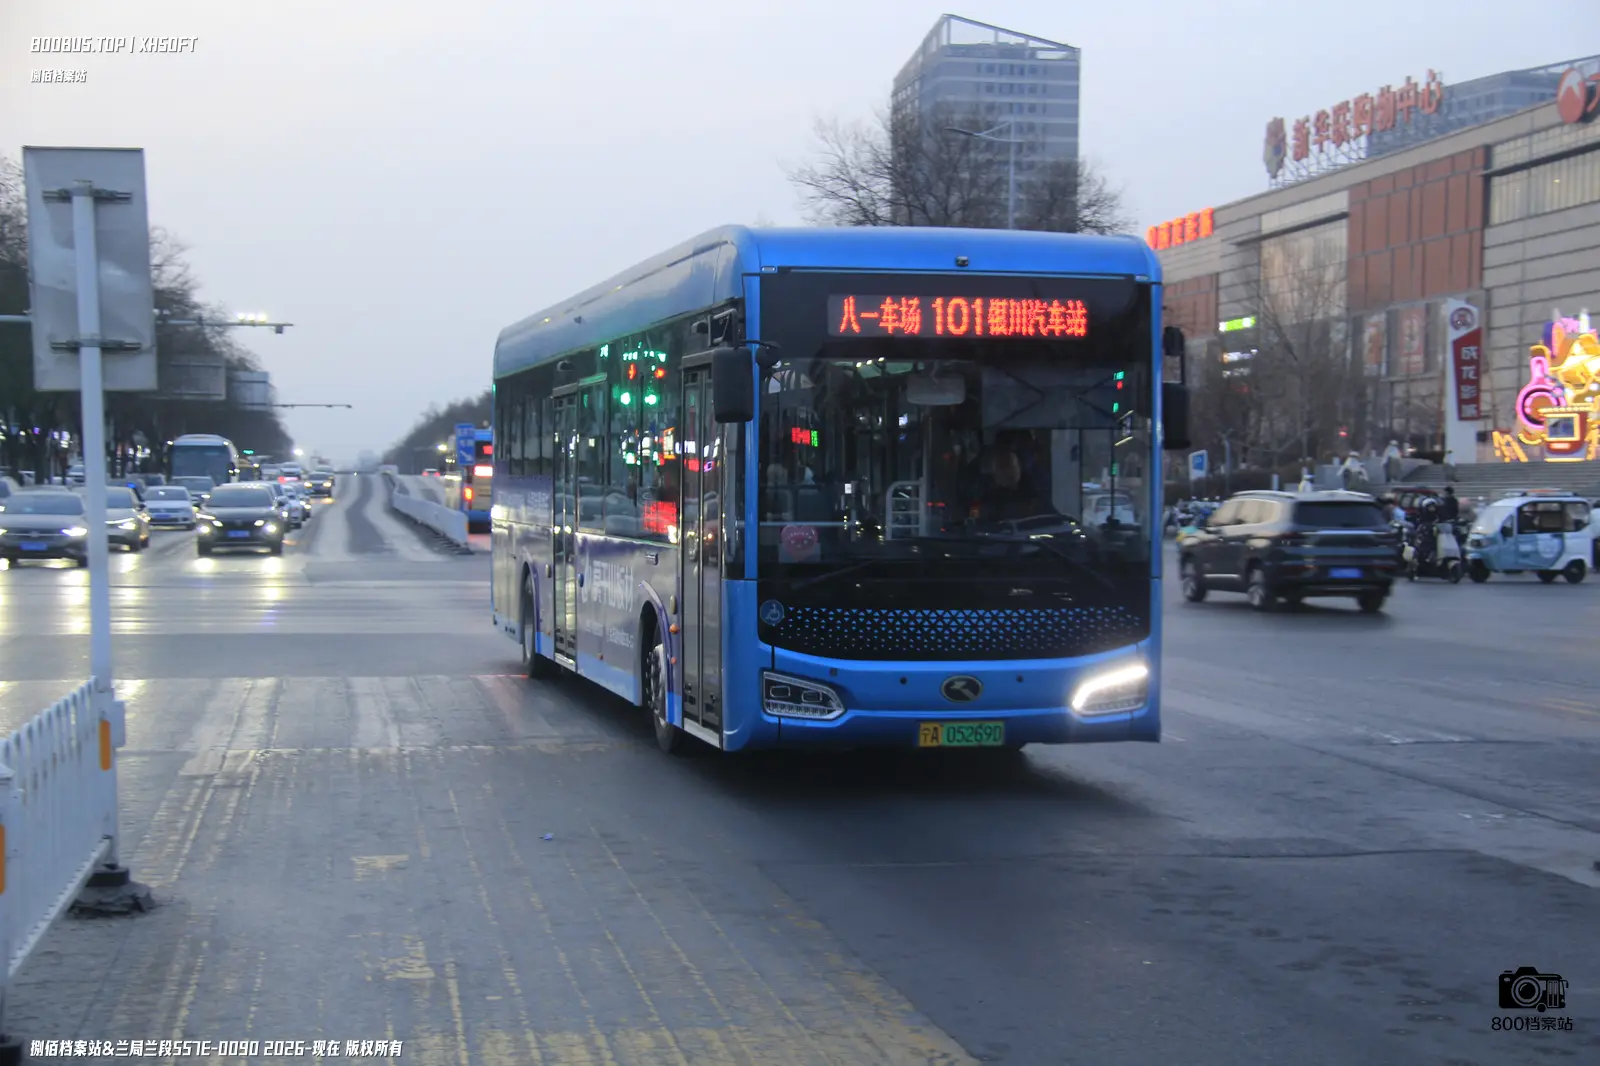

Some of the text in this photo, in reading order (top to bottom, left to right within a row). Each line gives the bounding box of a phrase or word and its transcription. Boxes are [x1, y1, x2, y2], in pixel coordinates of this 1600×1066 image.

[1293, 69, 1442, 161] 新华联购物中心
[839, 296, 1088, 336] 八一车场 101 银川汽车站
